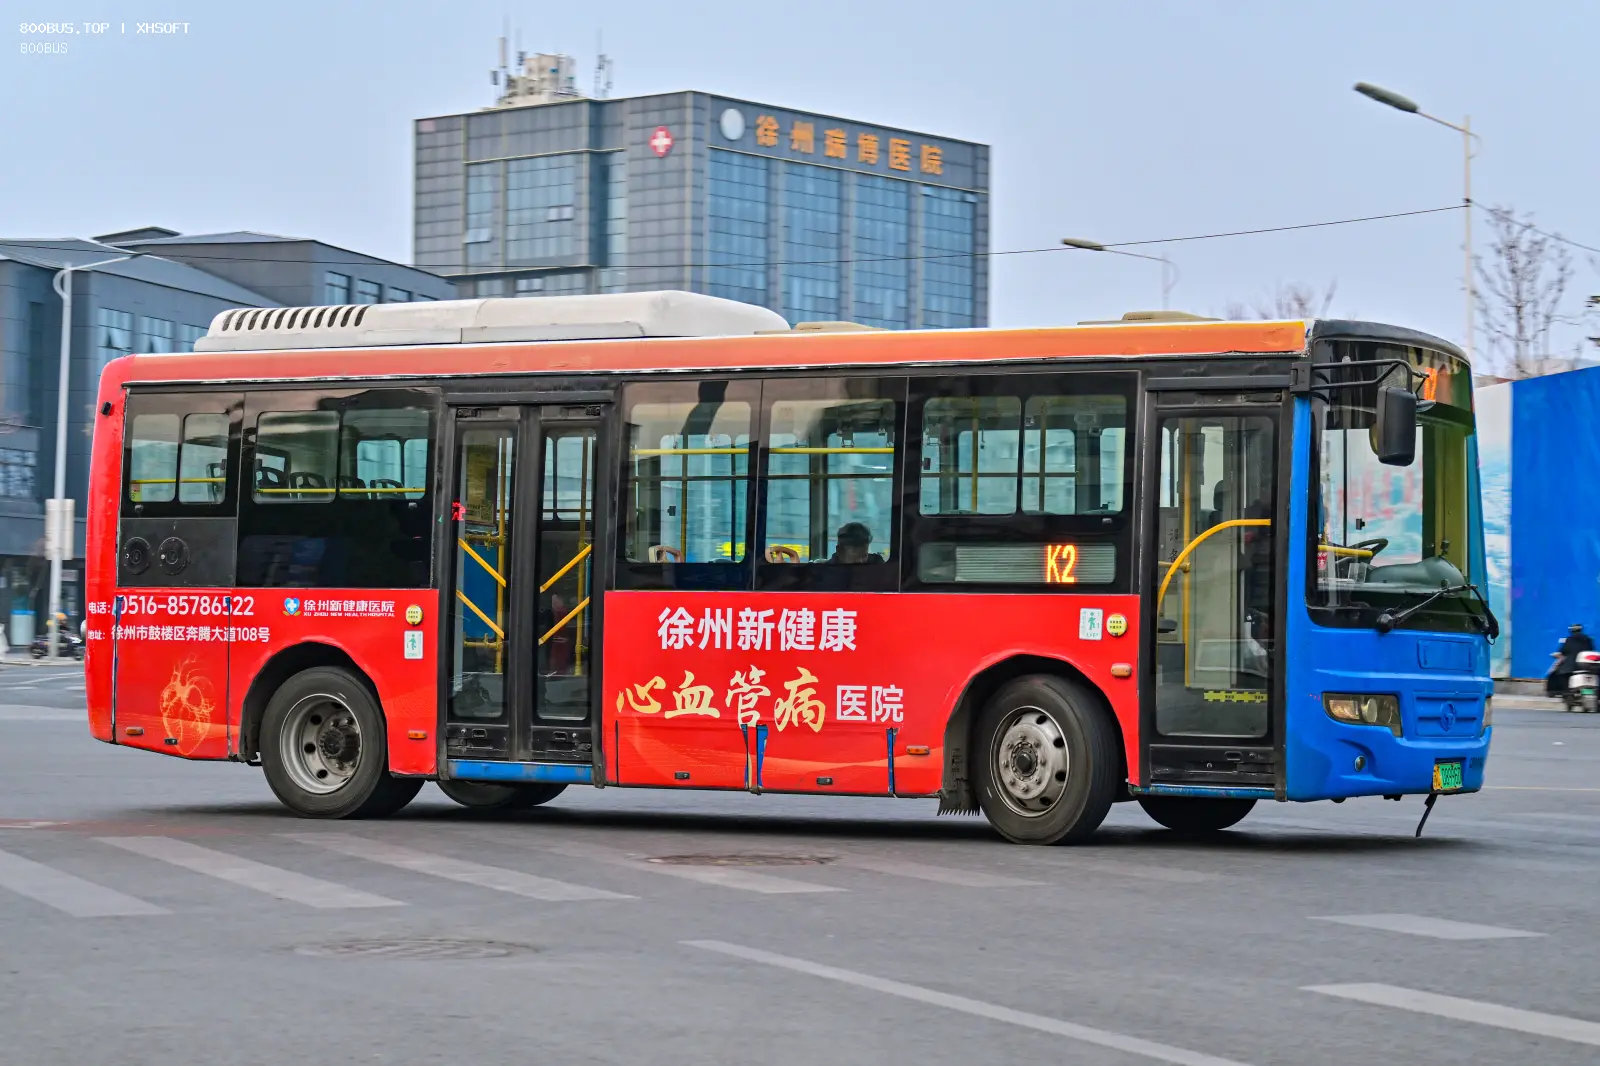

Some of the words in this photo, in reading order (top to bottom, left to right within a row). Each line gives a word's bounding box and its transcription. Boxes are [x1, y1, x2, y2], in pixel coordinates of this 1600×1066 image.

[1046, 544, 1077, 583] K2
[304, 600, 396, 612] 徐州新健康医院
[111, 624, 271, 643] 徐州市鼓楼区奔腾大道108号
[656, 606, 859, 652] 徐州新健康
